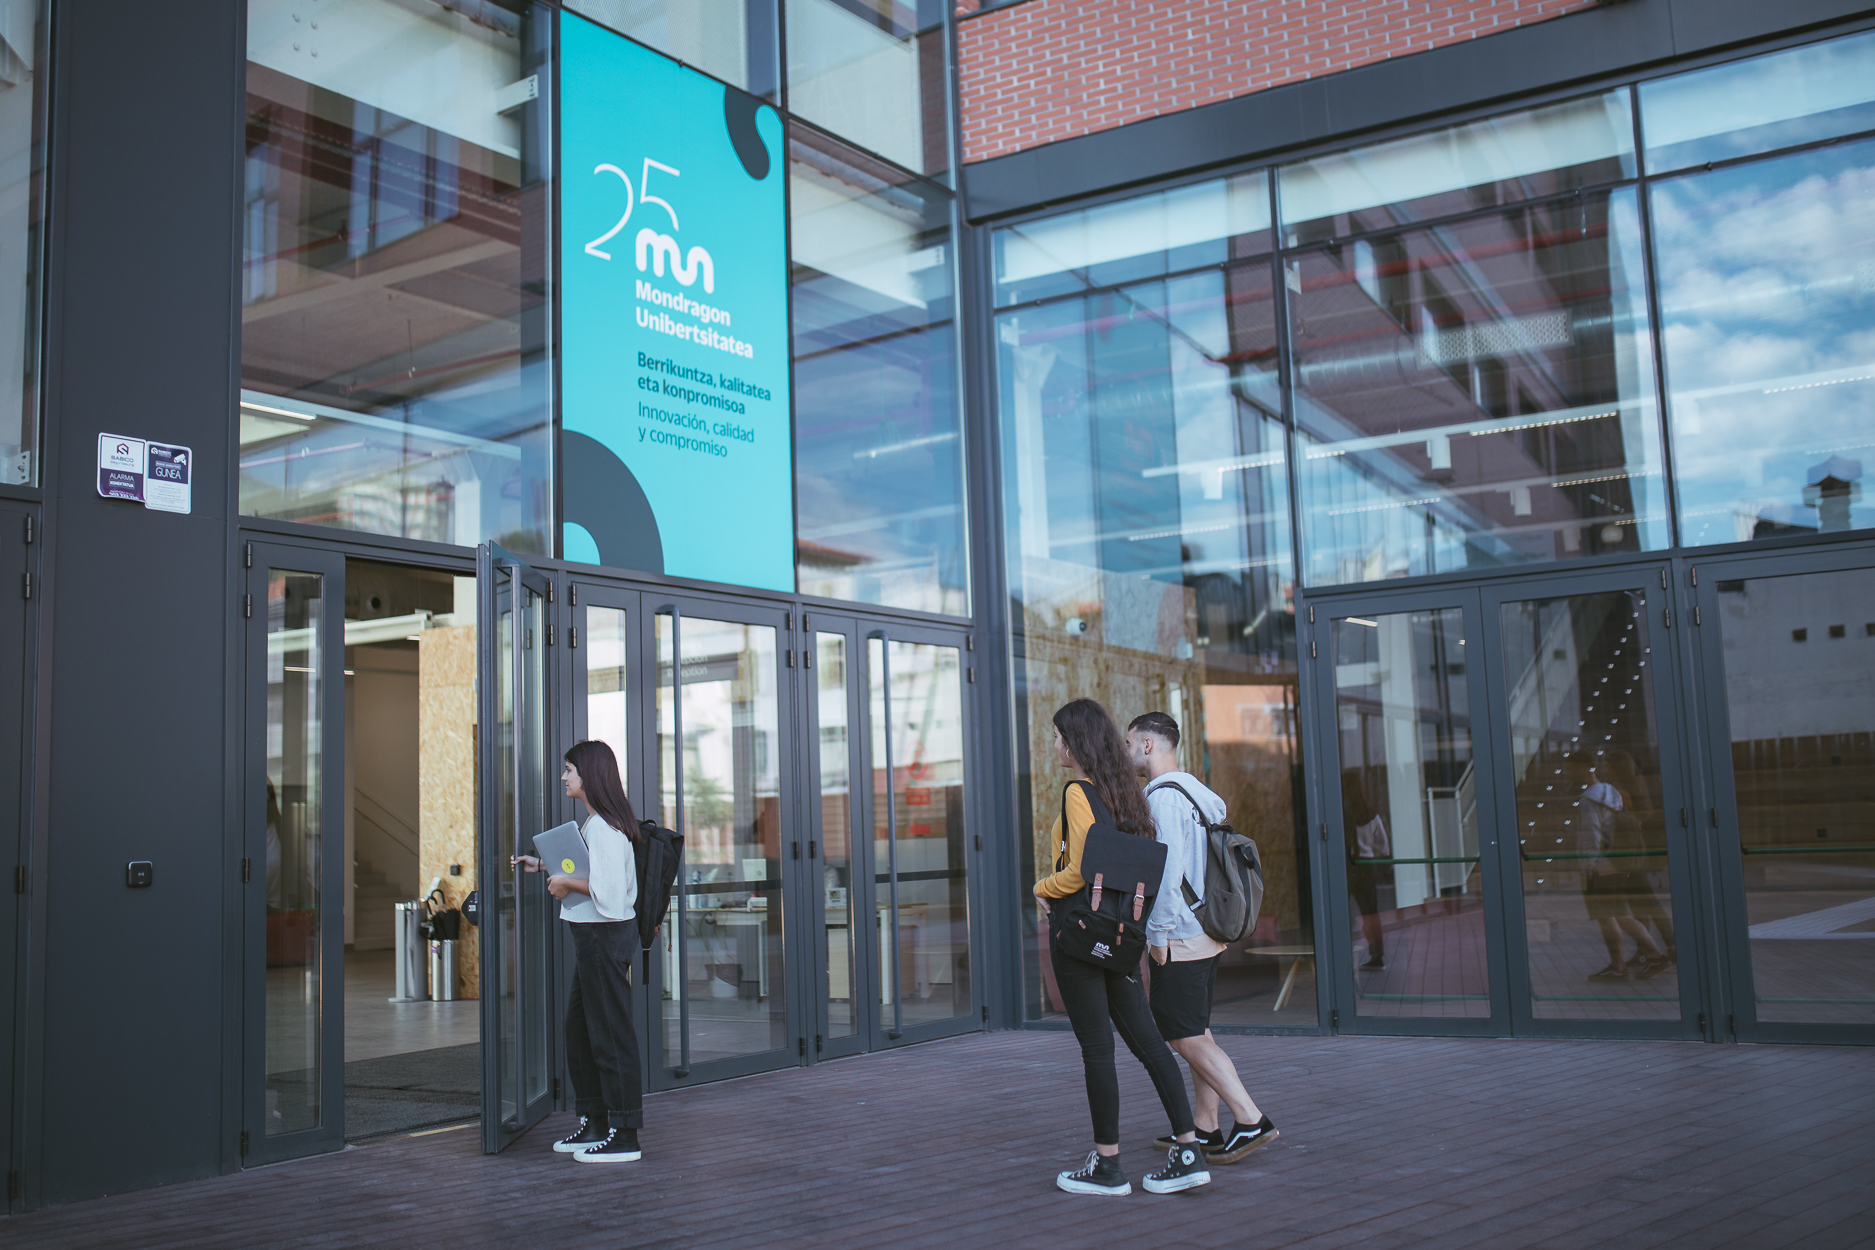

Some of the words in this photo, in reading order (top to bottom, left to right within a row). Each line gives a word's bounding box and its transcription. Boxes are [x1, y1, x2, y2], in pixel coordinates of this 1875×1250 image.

[584, 157, 681, 261] 25
[636, 279, 731, 327] Mondragon
[636, 306, 754, 359] Unibertsitatea
[638, 351, 717, 388] Berrikuntza,
[719, 373, 771, 401] kalitatea
[638, 376, 660, 393] eta
[663, 379, 745, 415] konpromisoa
[638, 401, 710, 434] Innovación,
[713, 422, 755, 443] calidad
[638, 426, 646, 442] y
[650, 428, 728, 458] compromiso
[109, 472, 135, 481] ALARMA
[156, 467, 182, 479] GUNEA
